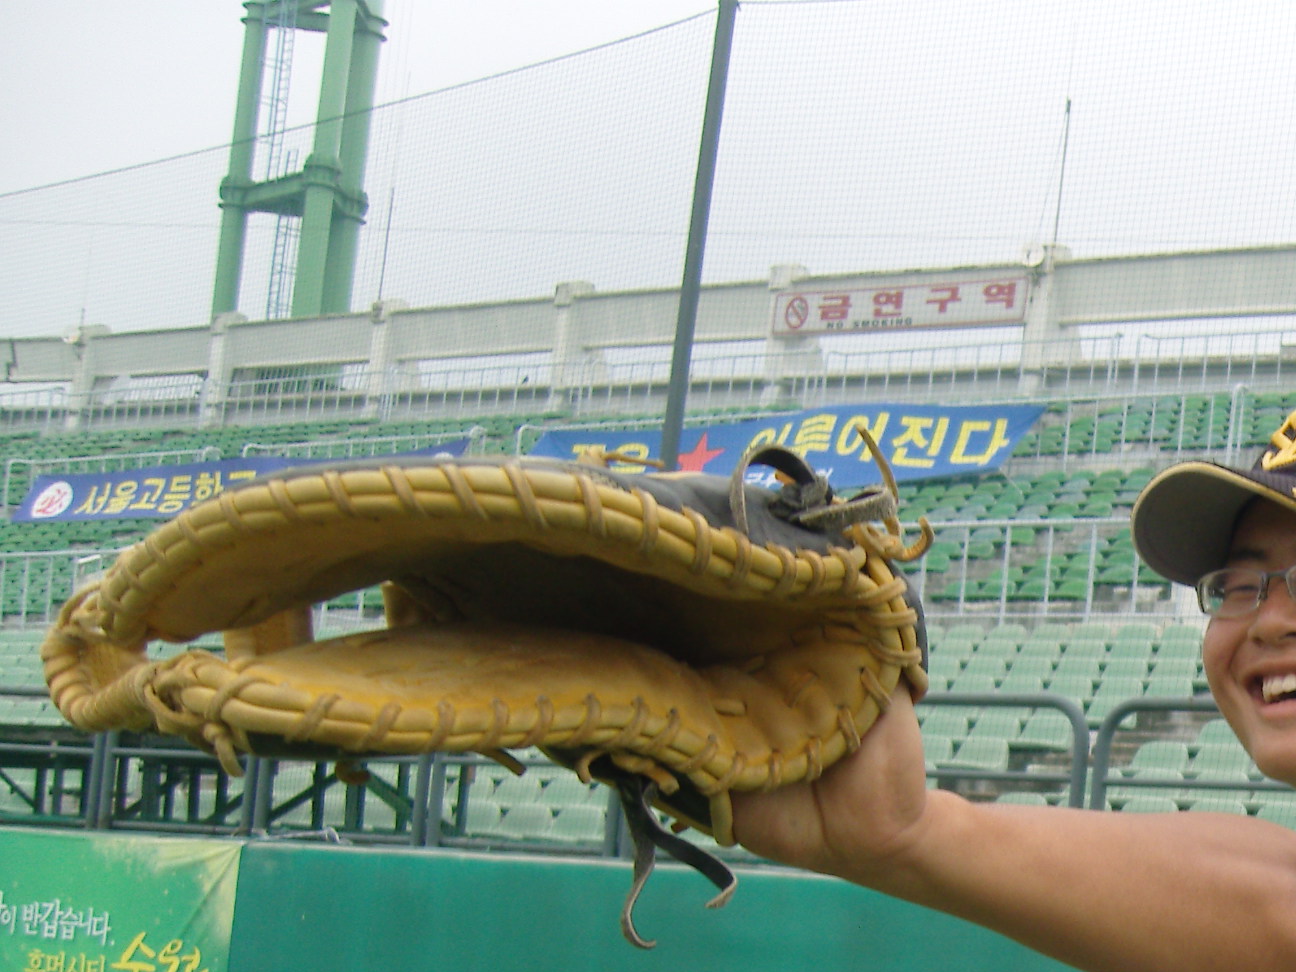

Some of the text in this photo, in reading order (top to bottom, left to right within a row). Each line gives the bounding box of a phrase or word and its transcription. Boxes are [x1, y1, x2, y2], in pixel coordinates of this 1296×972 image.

[818, 282, 1017, 320] 금연구역
[826, 317, 913, 330] NO SMOKING
[744, 412, 1011, 469] 이루어진다
[22, 898, 115, 946] 반갑습니다.
